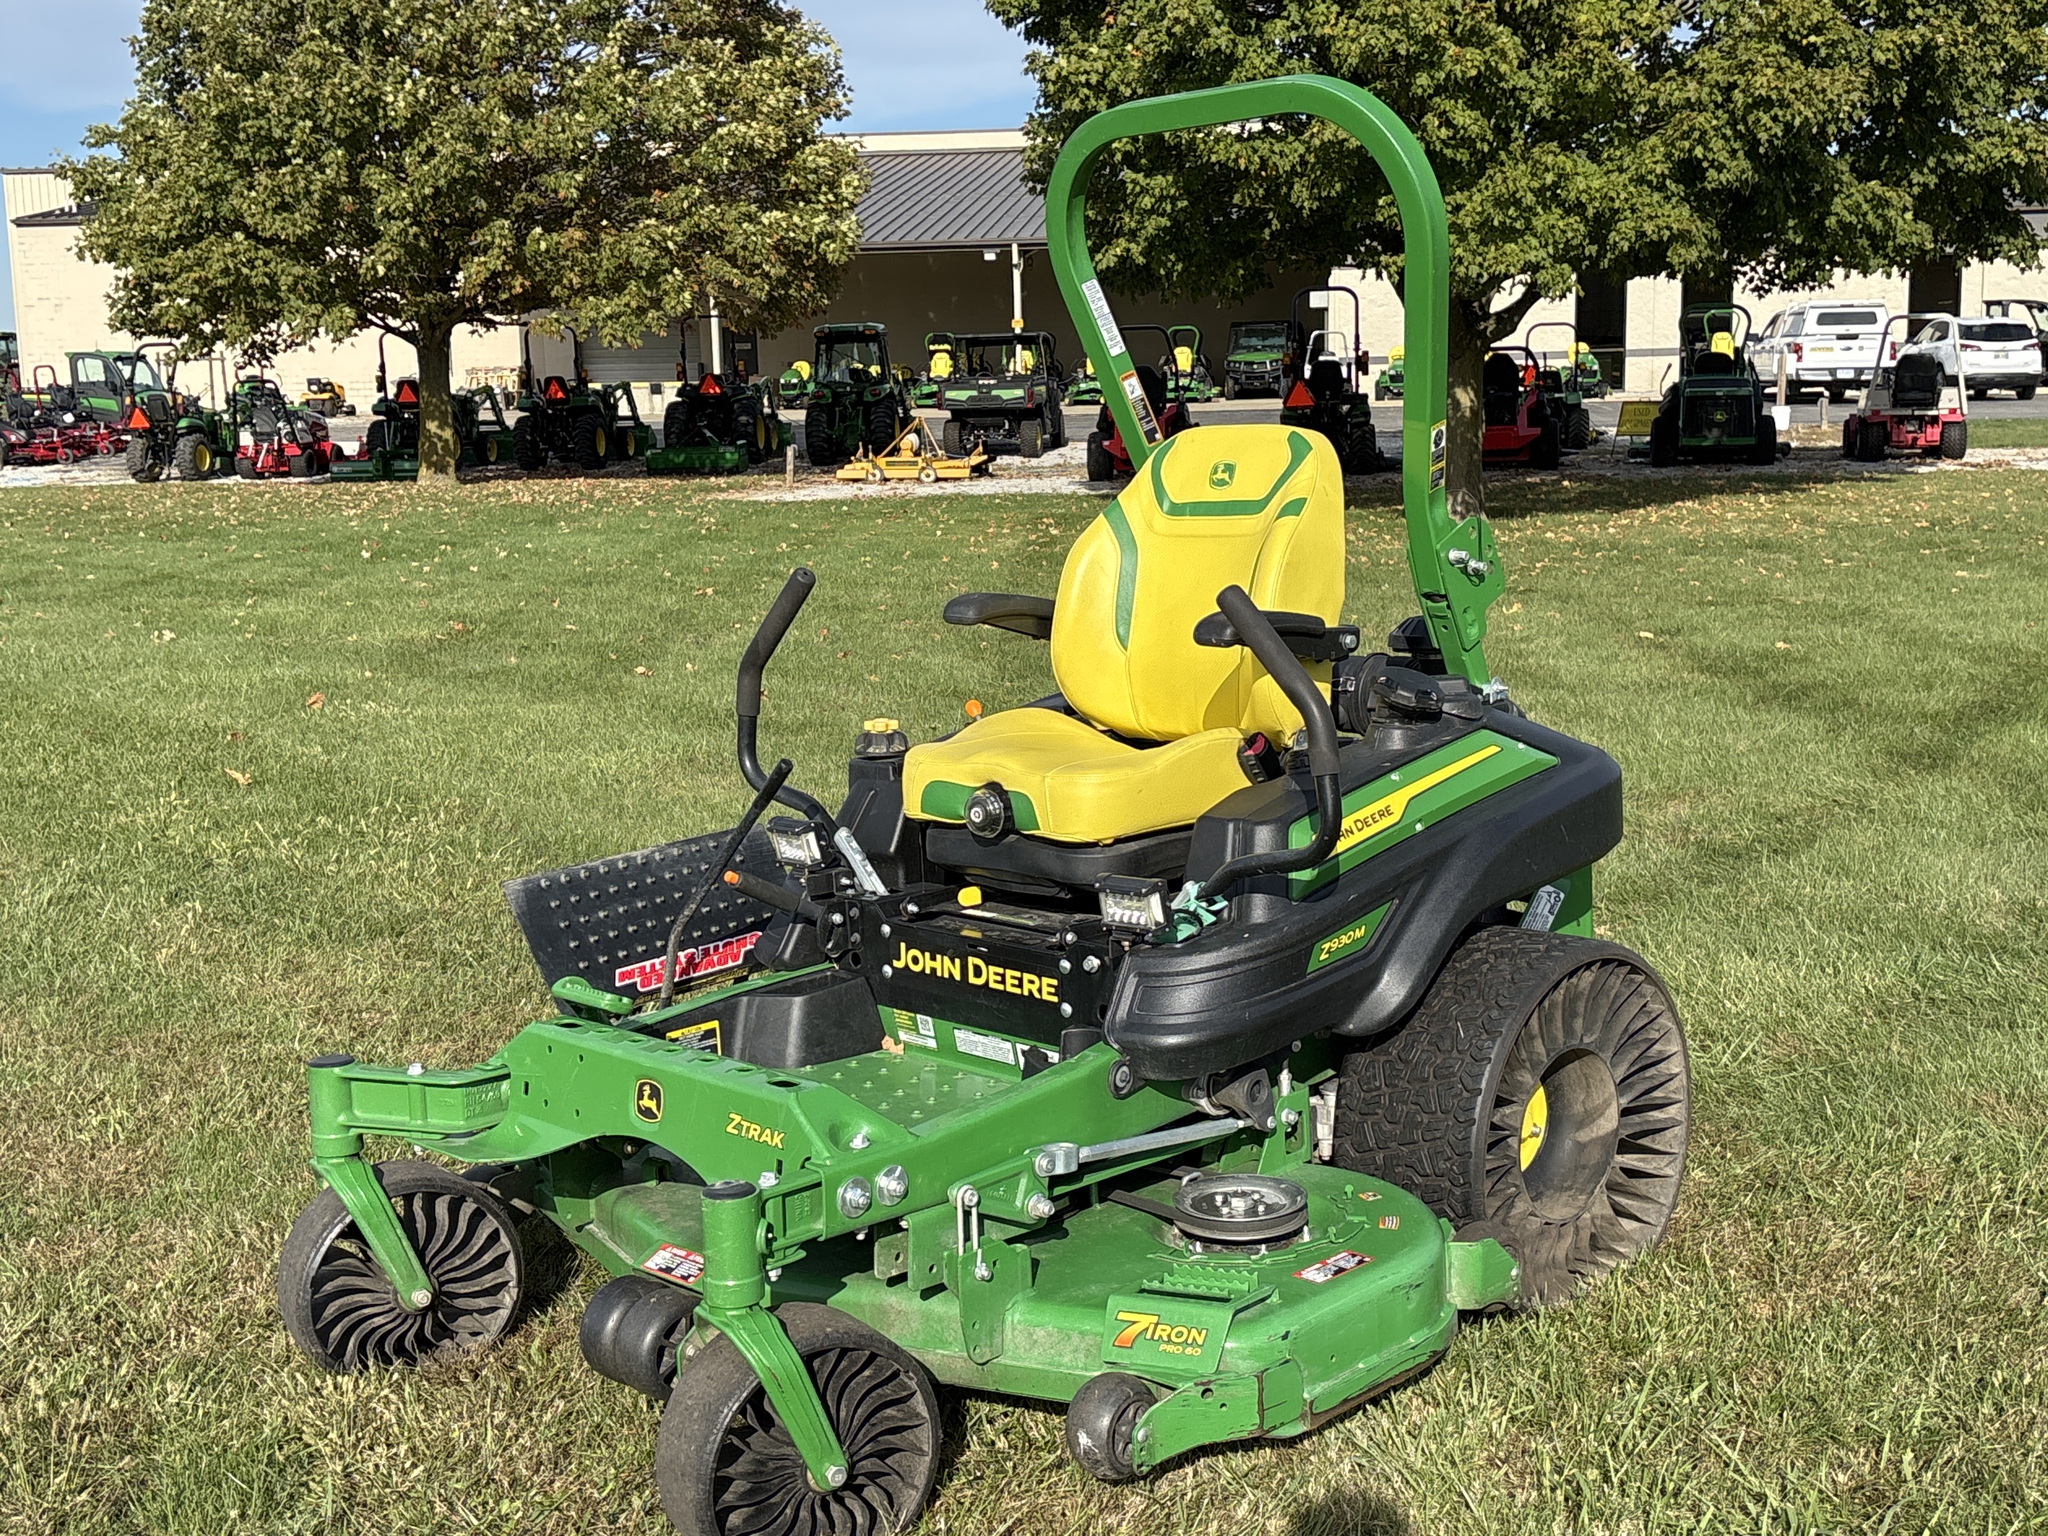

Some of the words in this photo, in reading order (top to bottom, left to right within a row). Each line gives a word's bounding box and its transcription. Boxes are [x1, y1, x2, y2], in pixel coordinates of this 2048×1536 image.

[1338, 825, 1355, 842] HN
[1353, 804, 1394, 833] DEERE
[1318, 924, 1366, 962] Z930M
[639, 949, 742, 989] ADVANED
[892, 941, 961, 981] JOHN
[967, 956, 1059, 1003] DEERE
[725, 1112, 786, 1149] ZTRAK
[1158, 1343, 1183, 1354] PRO
[1184, 1346, 1202, 1356] 60
